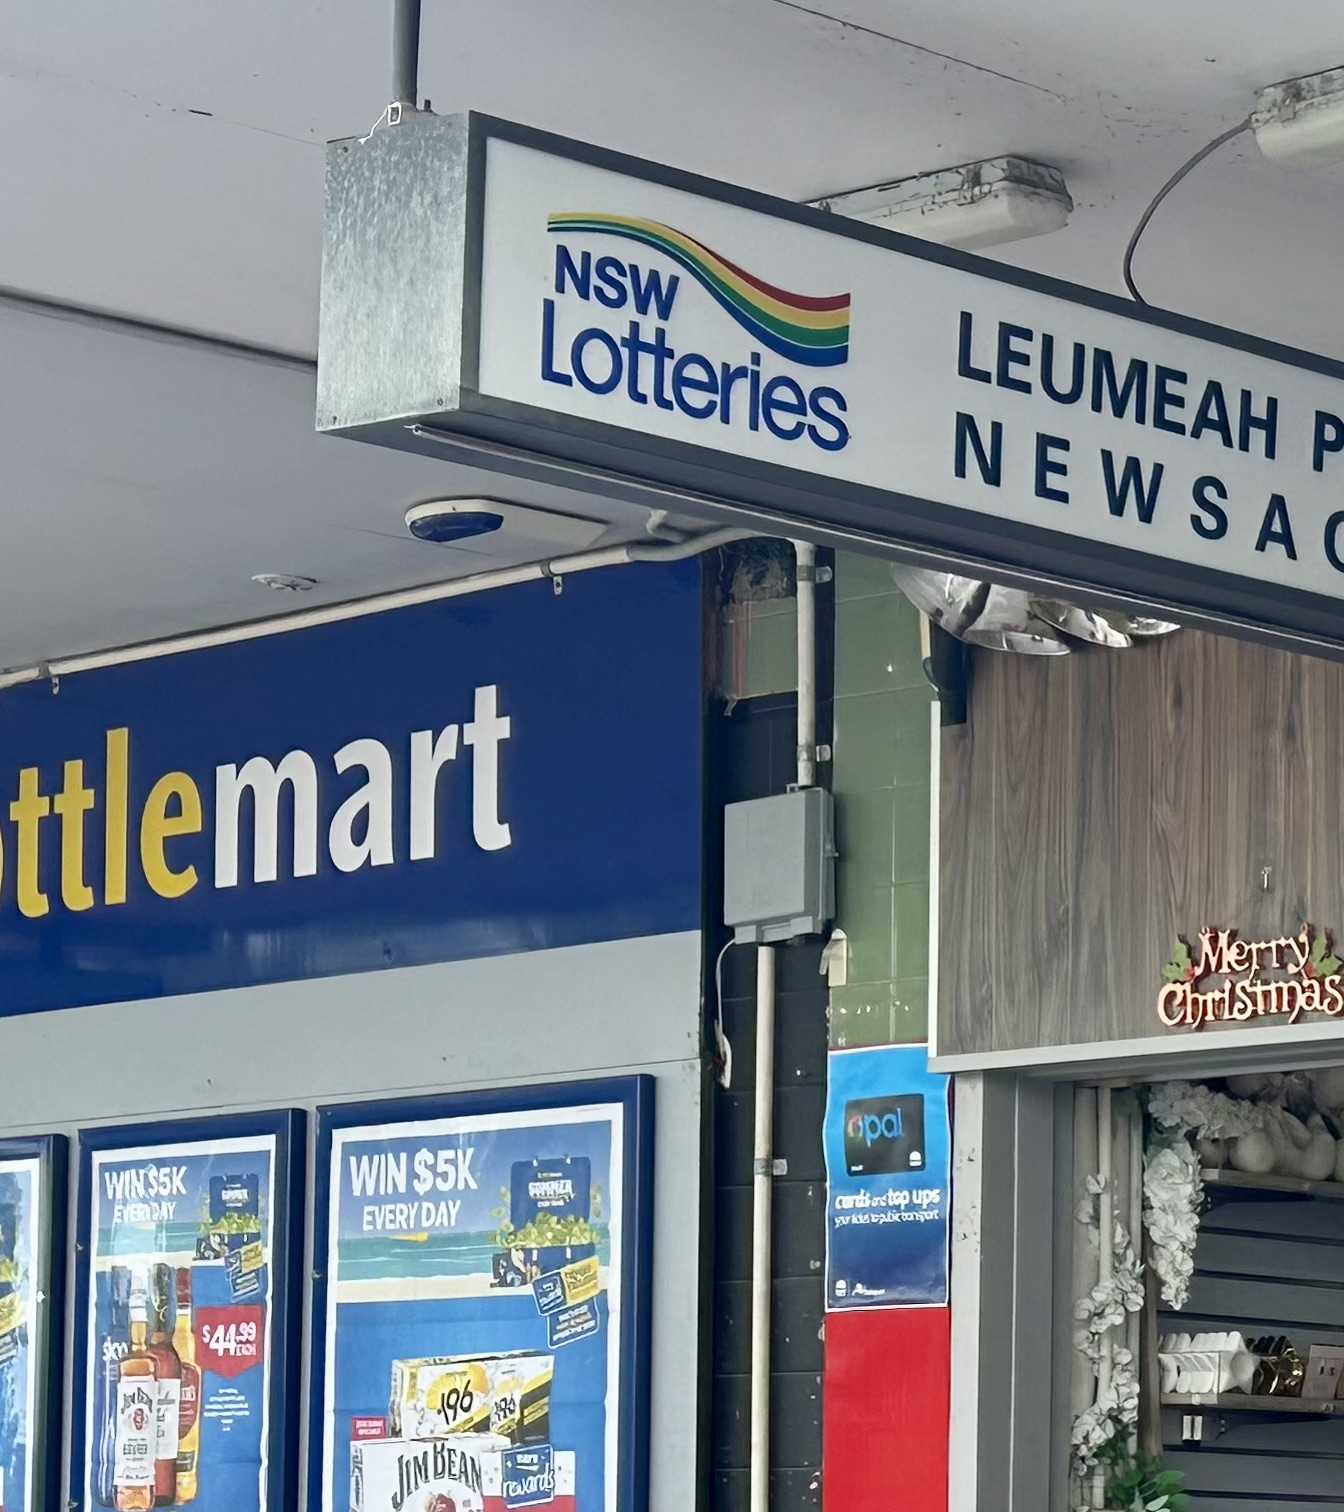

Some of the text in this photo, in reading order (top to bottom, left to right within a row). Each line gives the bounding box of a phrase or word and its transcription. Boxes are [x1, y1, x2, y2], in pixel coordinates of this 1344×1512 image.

[554, 243, 680, 322] NSW
[541, 298, 850, 451] Lotteries
[957, 310, 1279, 461] LEUMEAH
[0, 683, 512, 918] ttlemart
[1194, 925, 1311, 979] Merry
[1157, 975, 1344, 1030] Christmas
[847, 1107, 904, 1148] opal
[104, 1168, 147, 1200] WIN
[147, 1163, 188, 1198] $5K
[349, 1151, 408, 1197] WIN
[413, 1147, 479, 1196] $5K
[113, 1201, 177, 1224] EVERY DAY
[362, 1199, 462, 1232] EVERY DAY
[887, 1188, 910, 1210] top
[912, 1188, 941, 1209] ups
[202, 1322, 257, 1357] $44.99
[391, 1450, 430, 1512] JIM
[502, 1468, 555, 1500] rewards
